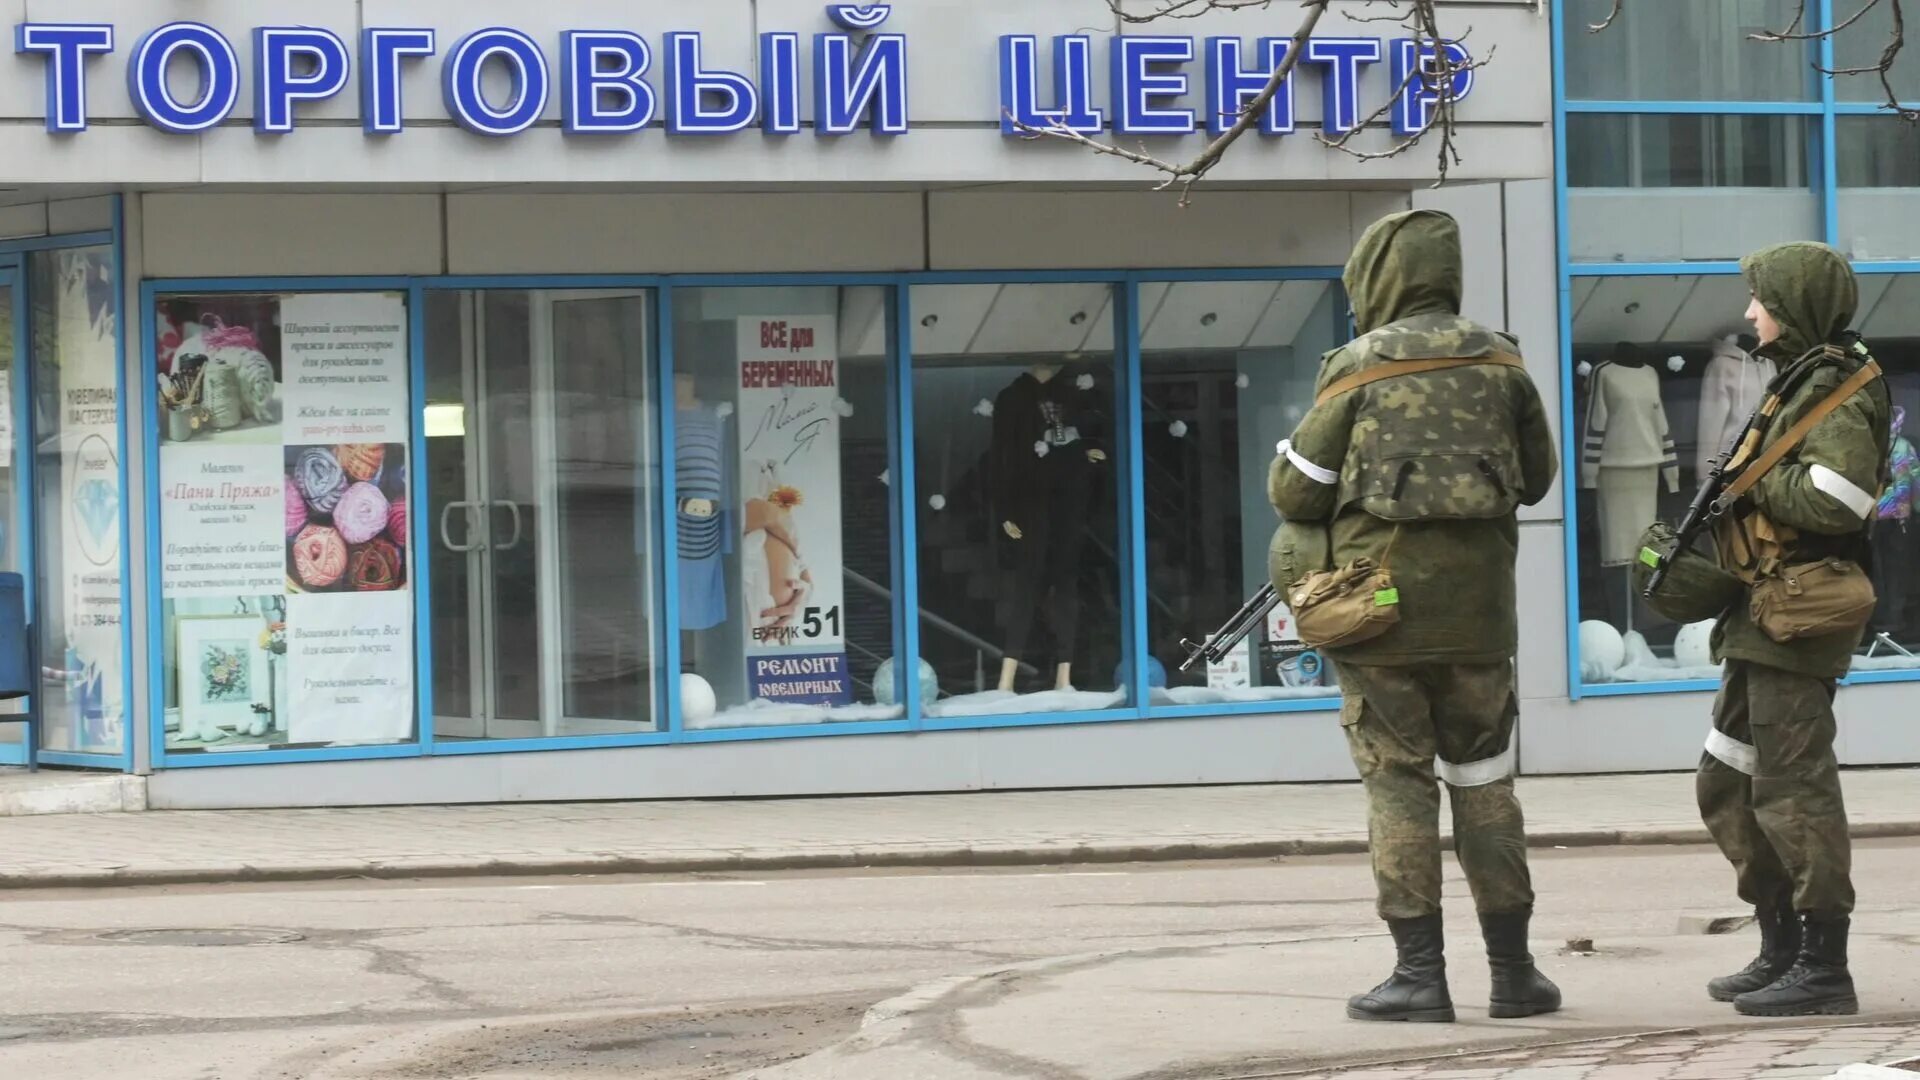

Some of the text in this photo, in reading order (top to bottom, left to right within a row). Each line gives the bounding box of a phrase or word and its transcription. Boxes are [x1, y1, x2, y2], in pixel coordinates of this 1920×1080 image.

[15, 4, 1474, 136] ТОРГОВЫЙ ЦЕНТР
[760, 321, 814, 352] ВСЕ для
[742, 360, 834, 388] БЕРЕМЕННЫХ
[166, 482, 280, 502] «Пани Пряжа»
[752, 605, 840, 640] БУТИК 51
[757, 657, 839, 676] РЕМОНТ
[758, 680, 842, 697] ЮВЕЛИРНЫХ
